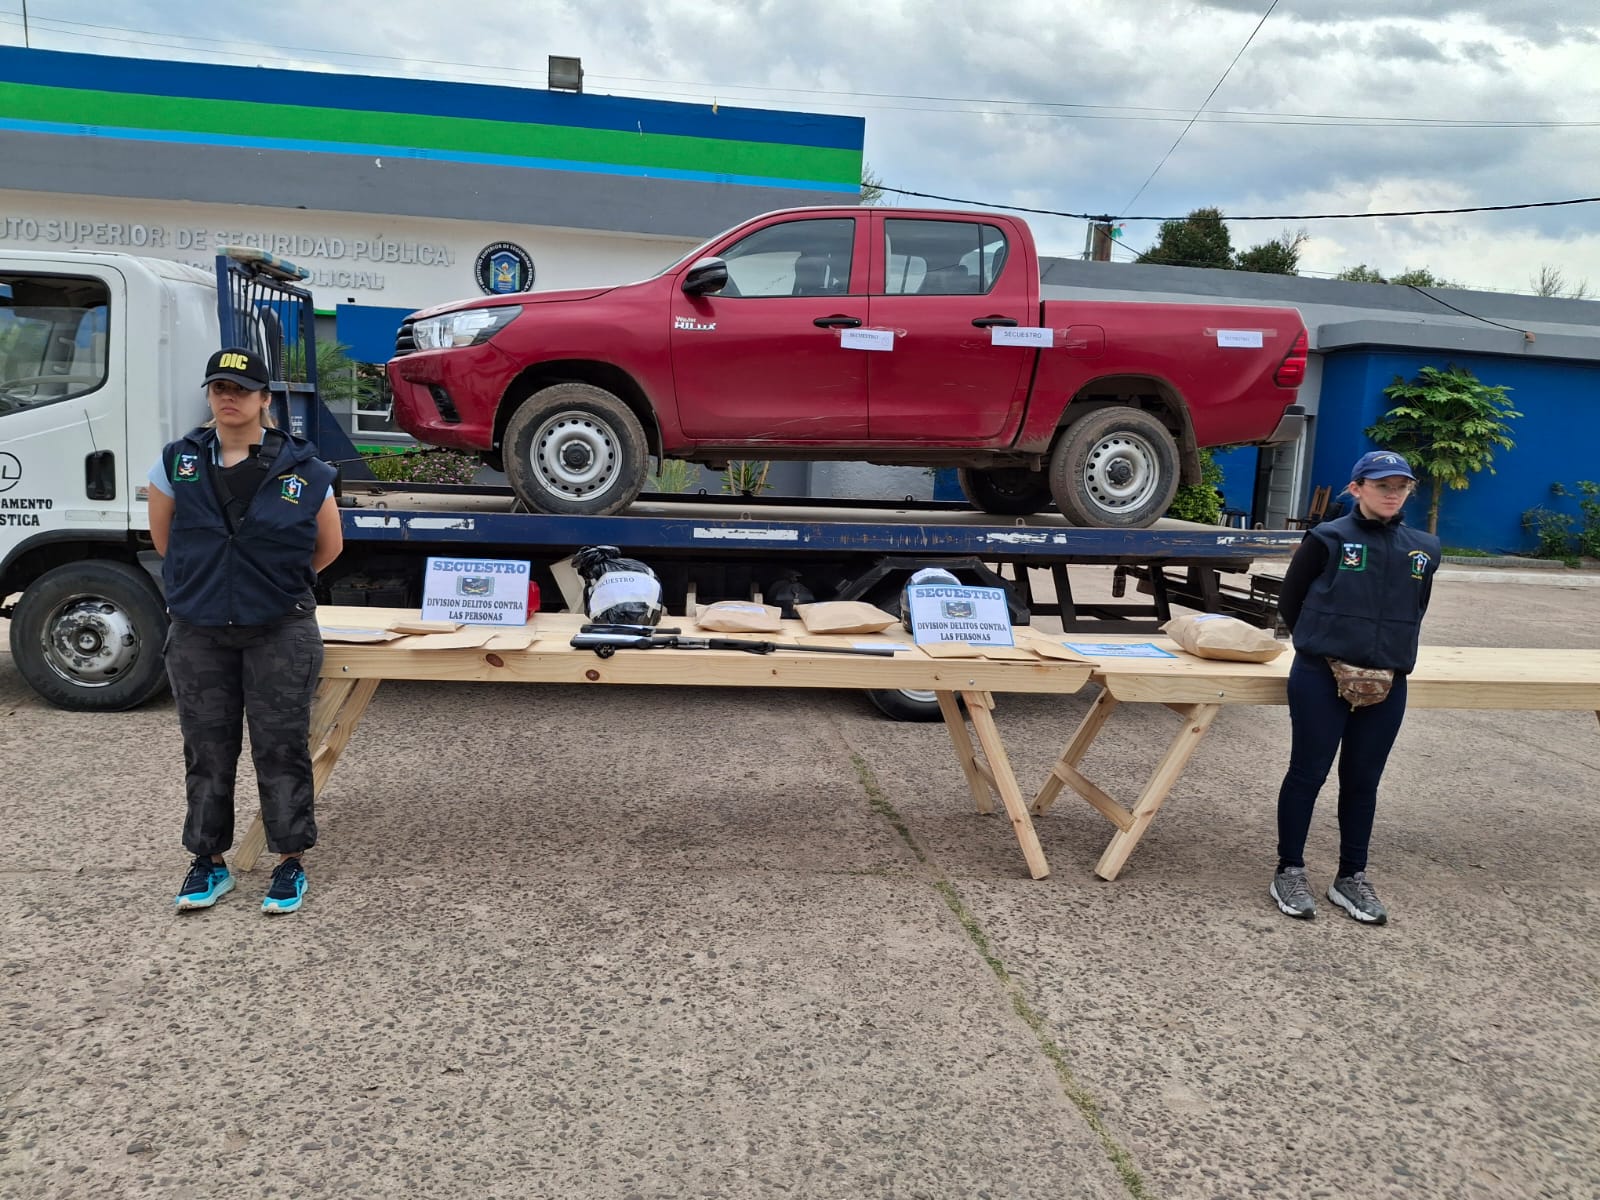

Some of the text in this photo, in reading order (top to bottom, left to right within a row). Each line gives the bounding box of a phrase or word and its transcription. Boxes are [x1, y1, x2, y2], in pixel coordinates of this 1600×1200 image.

[46, 220, 164, 248] SUPERIOR
[175, 228, 208, 250] DE
[215, 231, 346, 260] SEGURIDAD
[352, 233, 450, 267] PÚBLICA
[1003, 330, 1042, 339] SECUESTRO
[1, 498, 53, 509] AMENTO
[433, 560, 527, 574] SECUESTRO
[916, 588, 1001, 600] SECUESTRO
[427, 598, 523, 610] DIVISION DELITOS CONTRA
[449, 611, 503, 621] LAS PERSONAS
[917, 622, 1007, 631] DIVISION DELITOS CONTRA
[940, 632, 991, 641] LAS PERSONAS
